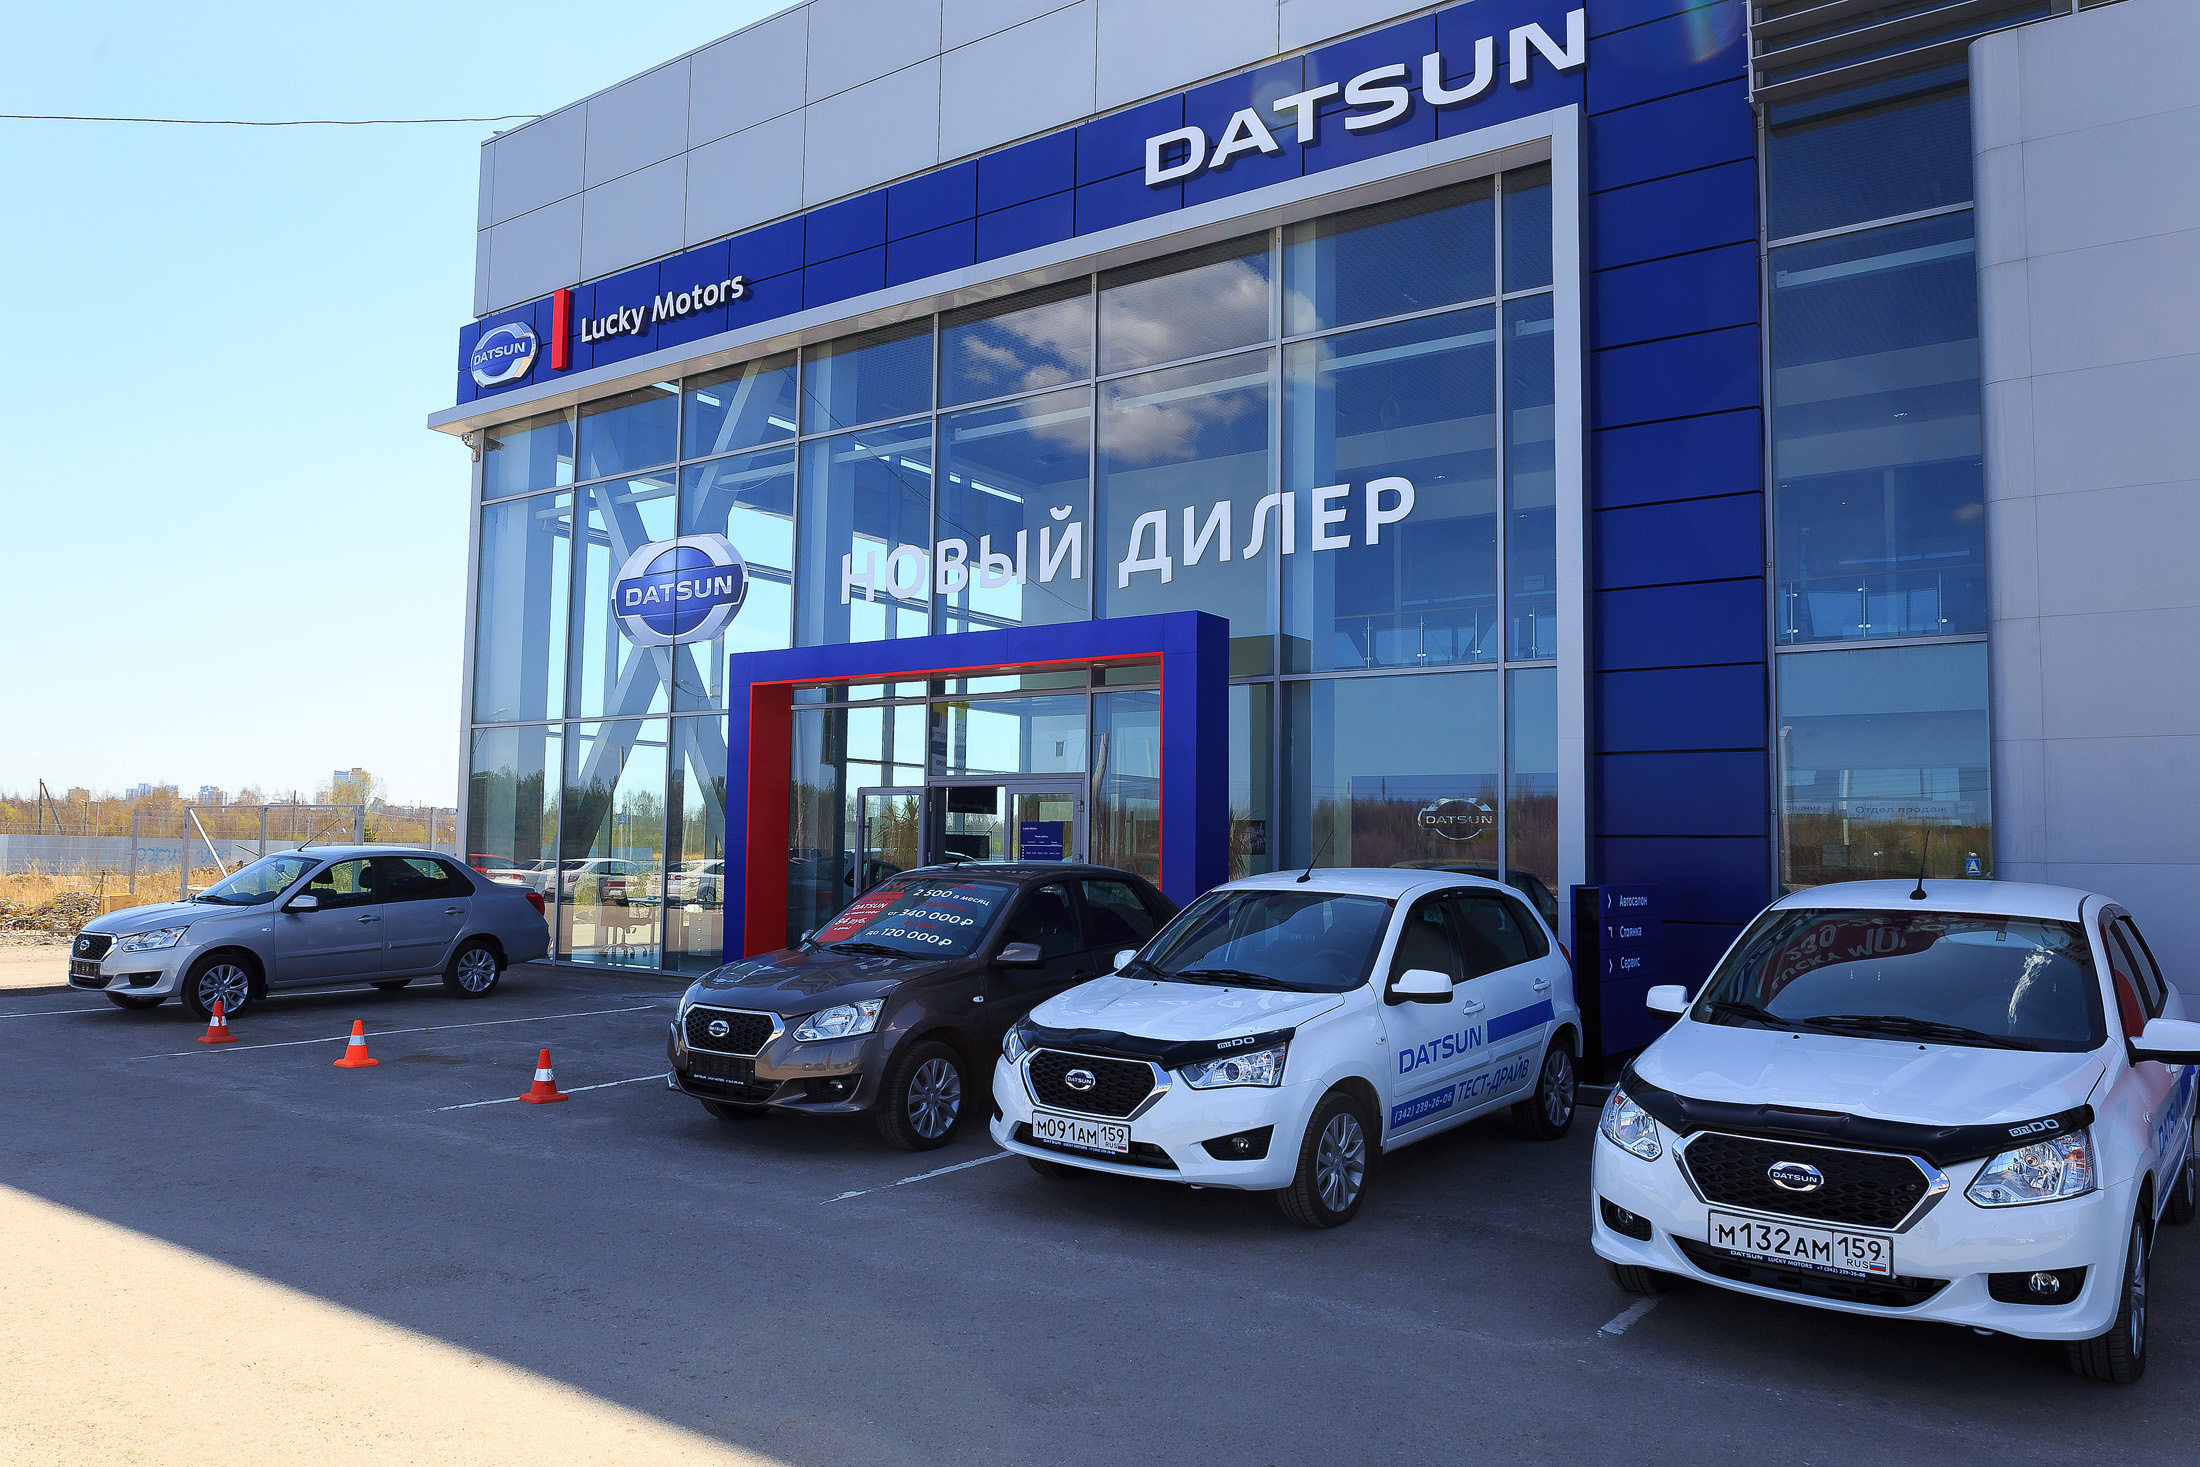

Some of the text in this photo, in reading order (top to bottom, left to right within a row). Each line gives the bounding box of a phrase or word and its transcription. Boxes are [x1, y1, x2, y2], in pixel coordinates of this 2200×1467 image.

[1145, 7, 1587, 186] DATSUN
[580, 275, 744, 342] Lucky Motors
[473, 340, 527, 367] DATSUN
[840, 475, 1416, 606] НОВЫЙ ДИЛЕР
[624, 574, 733, 607] DATSUN
[1425, 815, 1493, 824] DATSUN
[1855, 805, 1894, 815] Отдел
[1898, 805, 1948, 816] продаж
[960, 896, 990, 907] месяц
[1619, 895, 1648, 907] Автосалон
[1620, 956, 1641, 971] Сервис
[1398, 1025, 1482, 1075] DATSUN
[1067, 1075, 1092, 1085] DATSUN
[1457, 1055, 1530, 1103] ТЕСТ-ДРАЙВ
[1394, 1091, 1453, 1124] (342) 239-26-06
[1100, 1126, 1125, 1144] 159
[1105, 1141, 1118, 1149] RUS
[1772, 1171, 1818, 1184] DATSUN
[1837, 1236, 1882, 1261] 159
[1730, 1250, 1763, 1260] DATSUN
[1767, 1256, 1787, 1265] LUCKY
[1787, 1260, 1813, 1270] MOTORS
[1846, 1258, 1868, 1269] RUS
